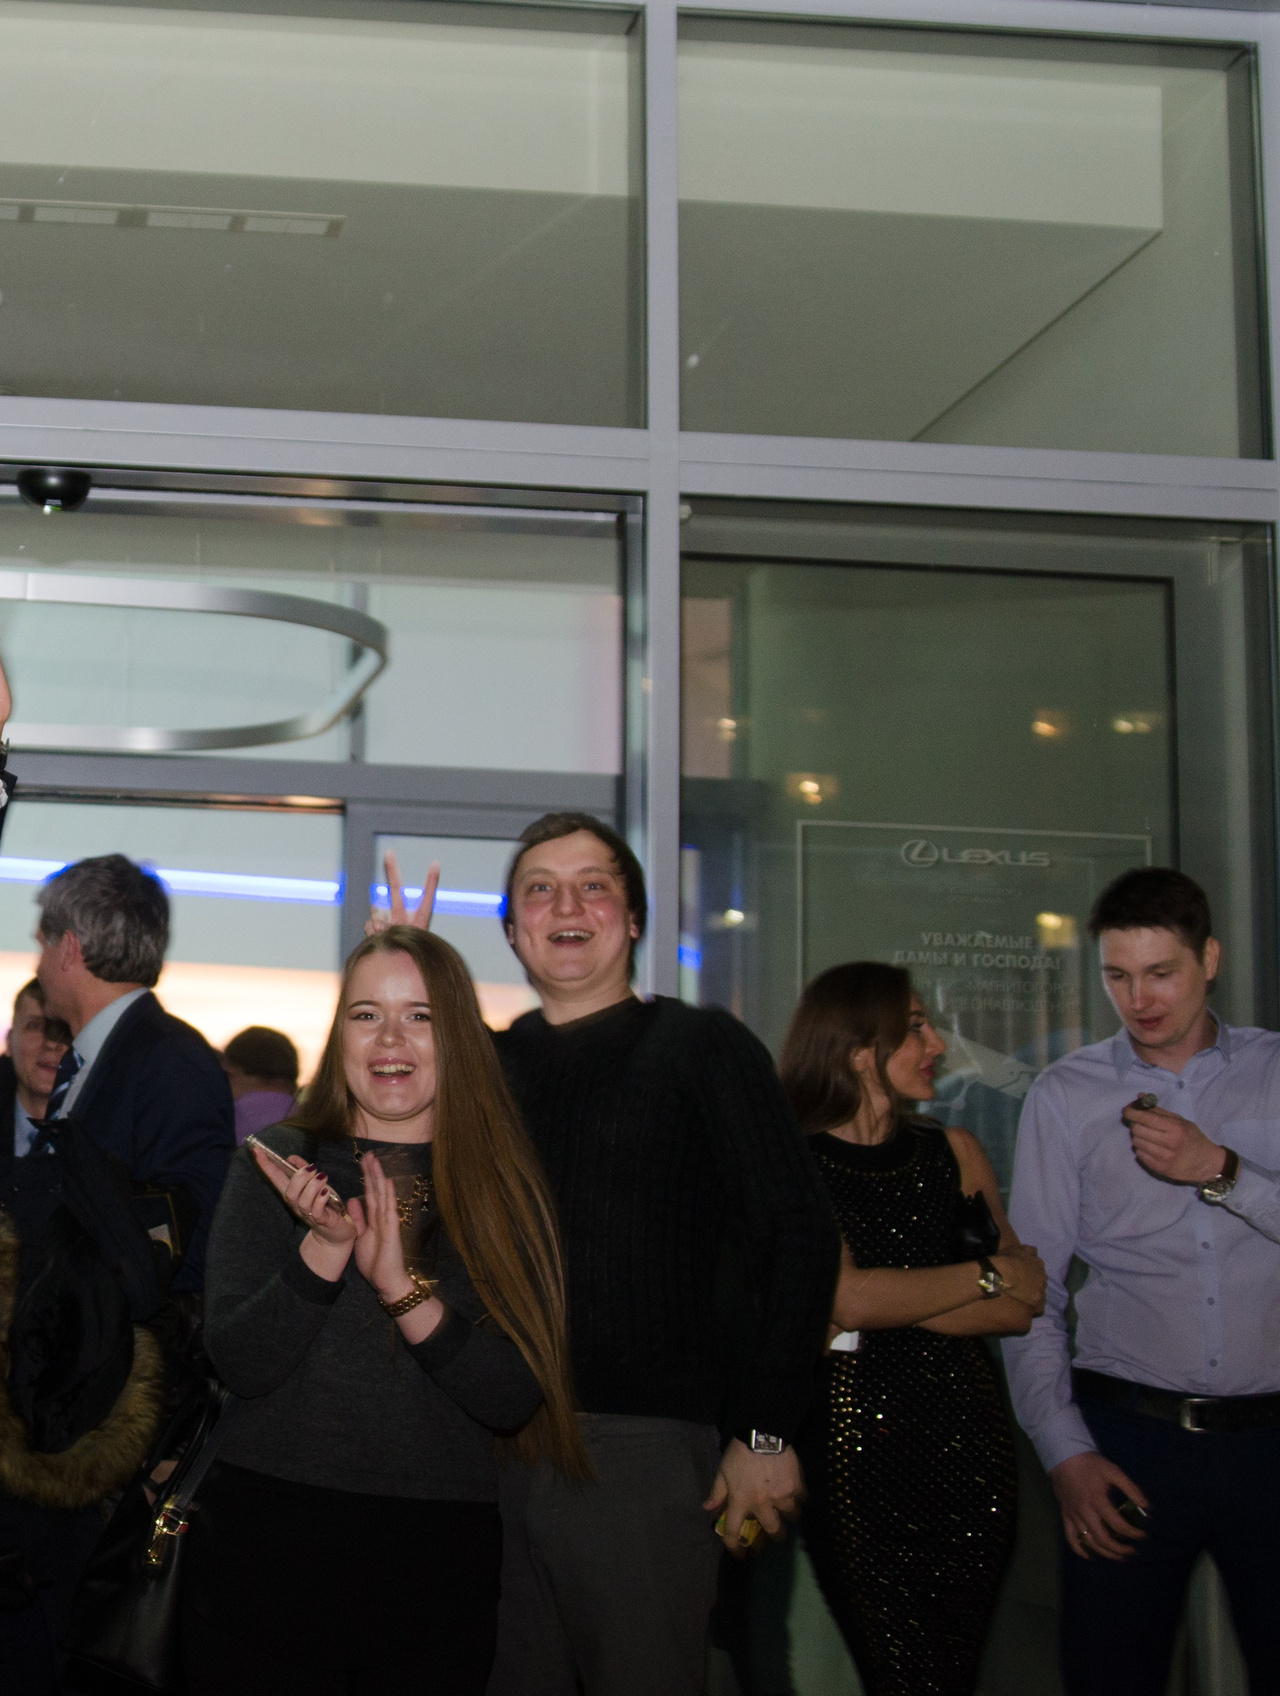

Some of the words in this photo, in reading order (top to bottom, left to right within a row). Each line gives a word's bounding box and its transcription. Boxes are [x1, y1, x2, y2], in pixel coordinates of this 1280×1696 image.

[942, 846, 1051, 867] LEXUS
[921, 931, 1033, 950] УВАЖАЕМЫЕ
[954, 953, 968, 967] И
